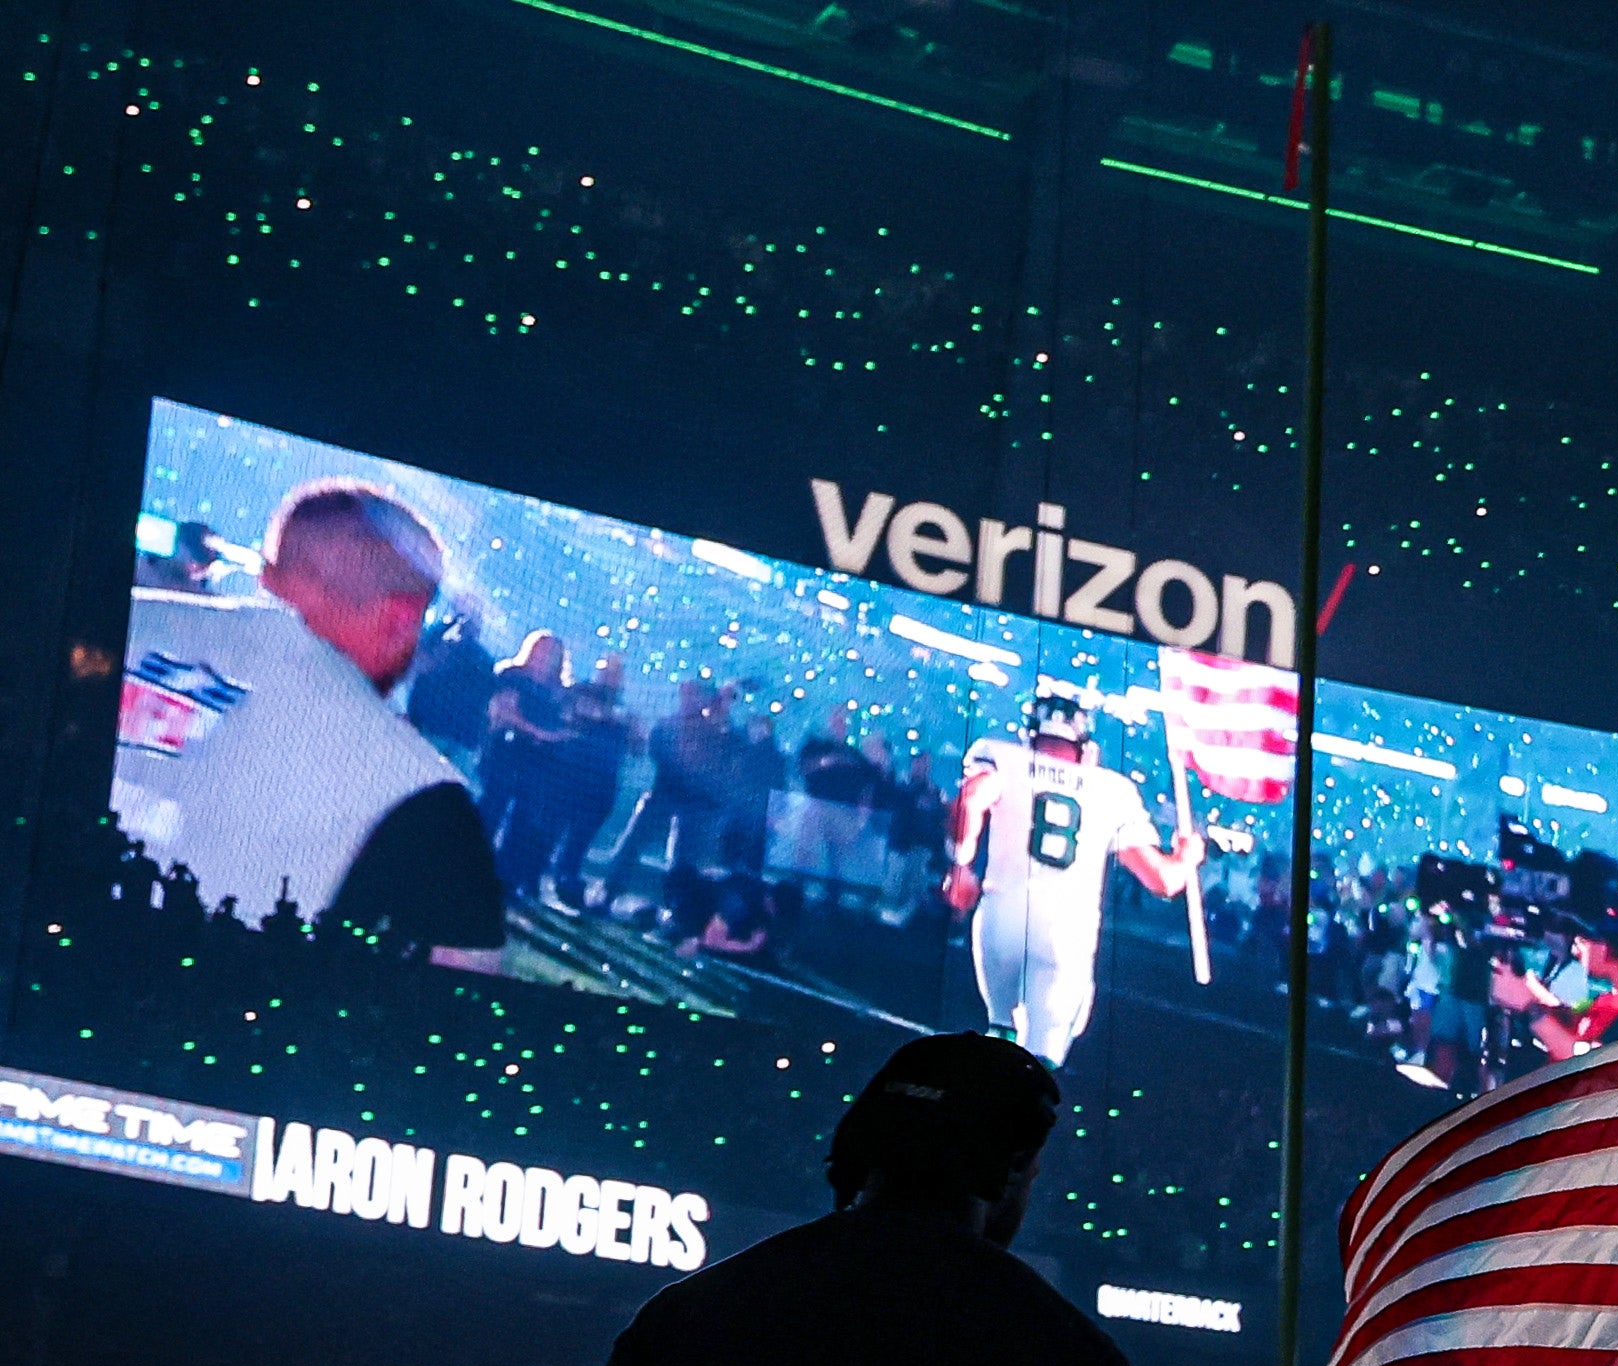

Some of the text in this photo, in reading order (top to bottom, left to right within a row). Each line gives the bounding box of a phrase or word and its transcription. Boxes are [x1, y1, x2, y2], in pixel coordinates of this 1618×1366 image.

[811, 478, 1297, 669] verizon
[1028, 792, 1081, 870] 8
[115, 1103, 248, 1158] TIME
[440, 1153, 712, 1273] RODGERS
